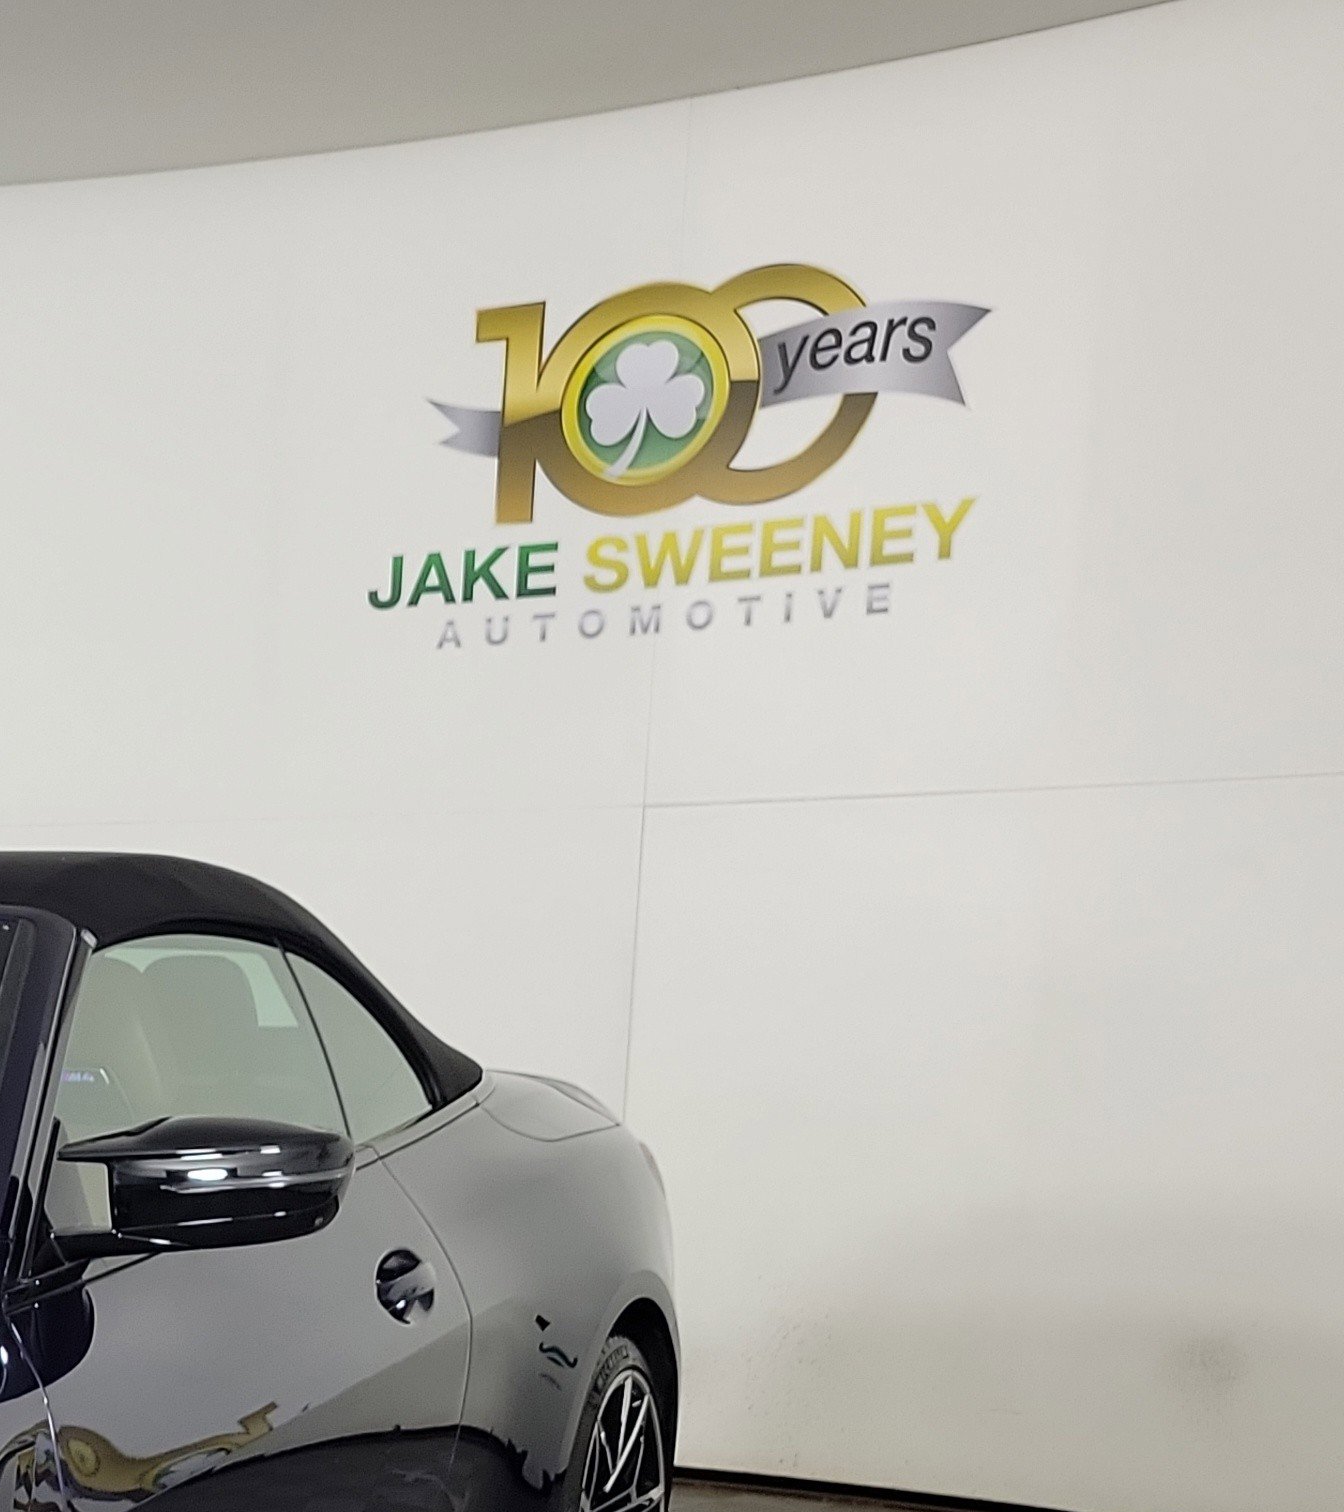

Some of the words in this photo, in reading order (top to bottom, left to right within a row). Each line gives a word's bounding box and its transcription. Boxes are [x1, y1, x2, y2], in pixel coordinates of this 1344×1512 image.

[475, 263, 878, 525] 100
[773, 315, 937, 393] years
[367, 541, 559, 611] JAKE
[583, 497, 977, 594] SWEENEY
[436, 583, 892, 650] AUTOMOTIVE
